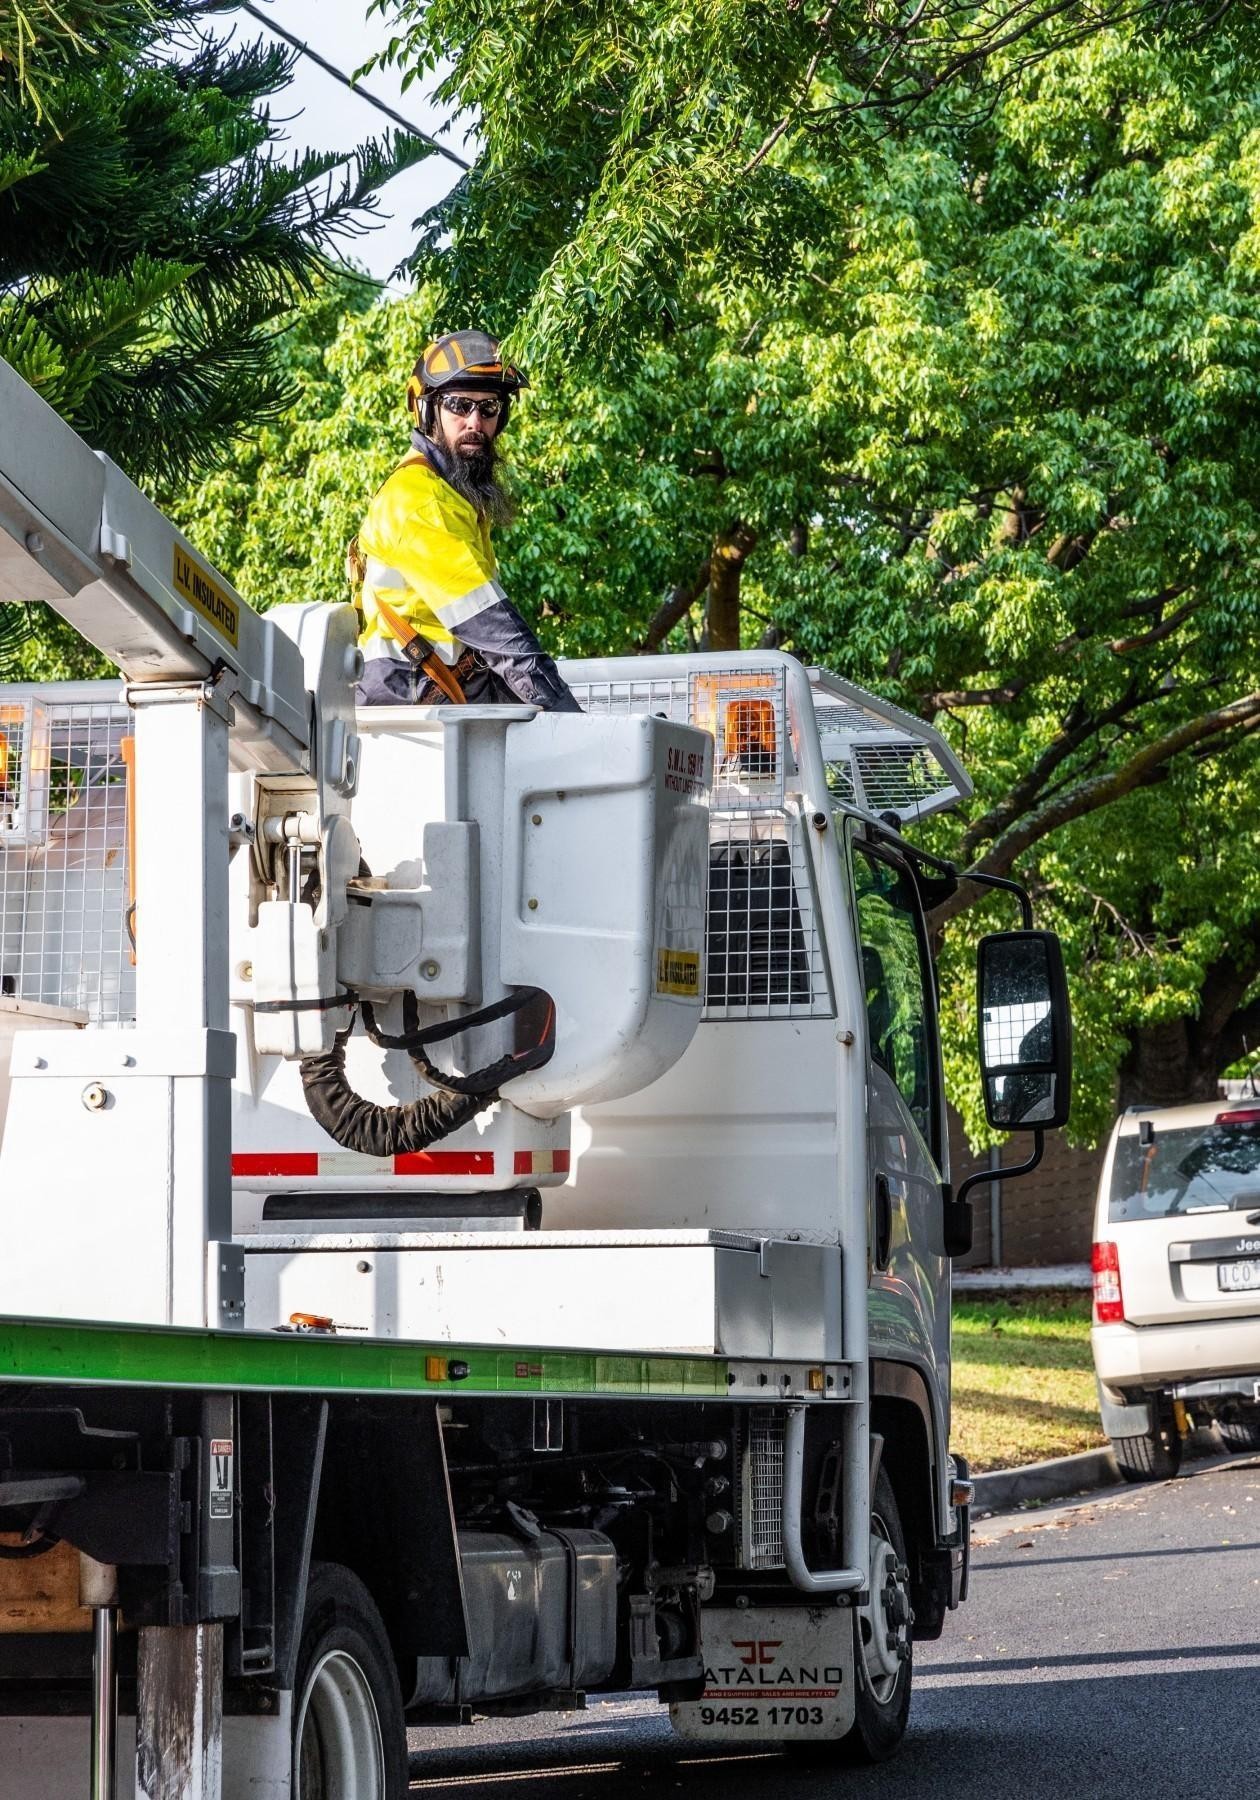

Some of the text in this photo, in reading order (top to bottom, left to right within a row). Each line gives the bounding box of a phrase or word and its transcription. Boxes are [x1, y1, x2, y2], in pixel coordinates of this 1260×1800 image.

[193, 573, 236, 635] INSULATED
[703, 1667, 842, 1684] ATALANO
[701, 1706, 823, 1725] 9452 1703
